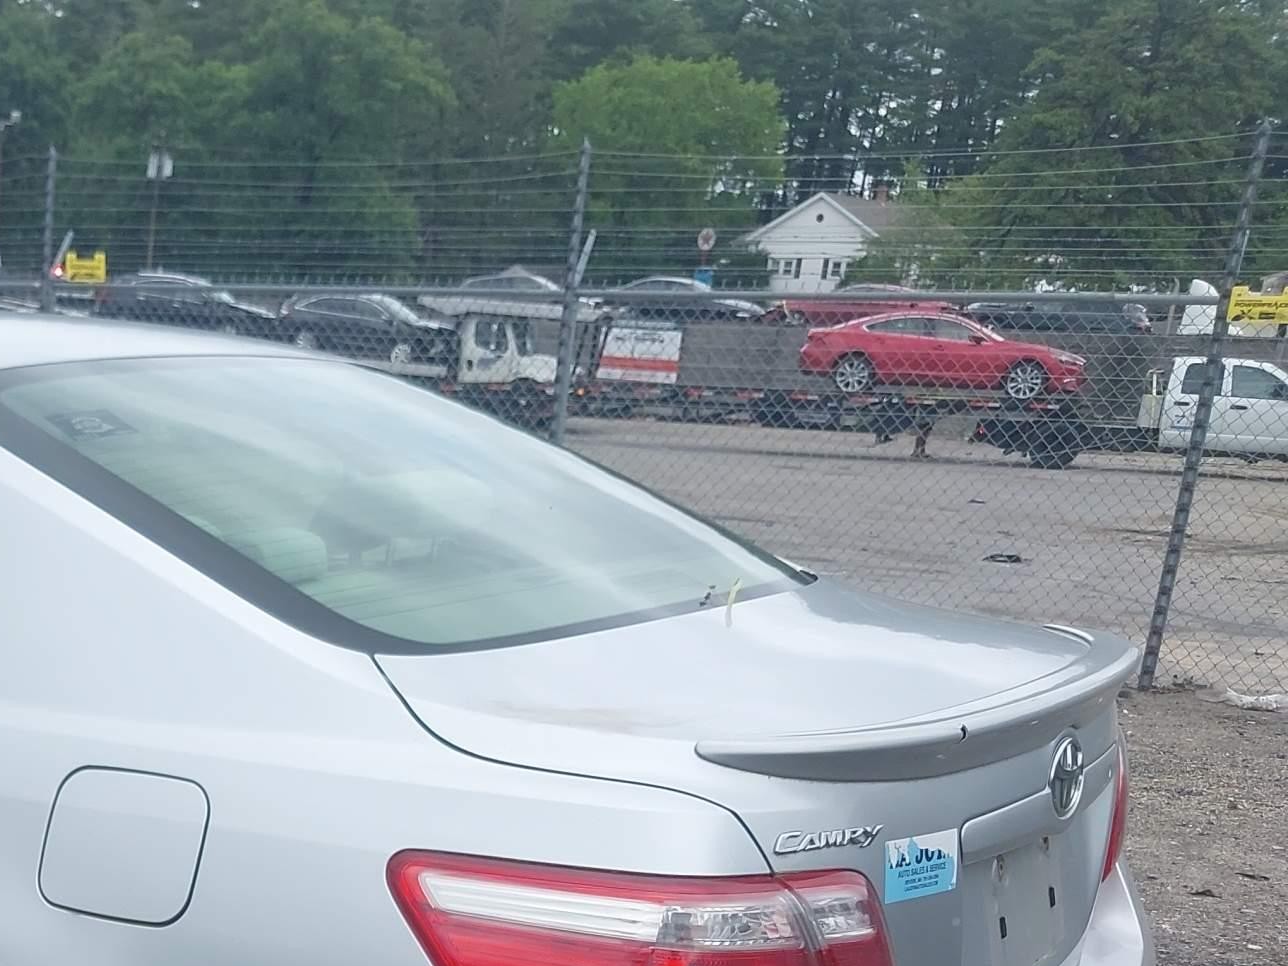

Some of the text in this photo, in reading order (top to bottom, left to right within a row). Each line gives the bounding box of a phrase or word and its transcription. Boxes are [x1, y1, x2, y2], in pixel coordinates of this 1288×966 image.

[775, 824, 885, 855] CAMRY
[898, 869, 910, 878] AUTO
[911, 866, 925, 876] SALES
